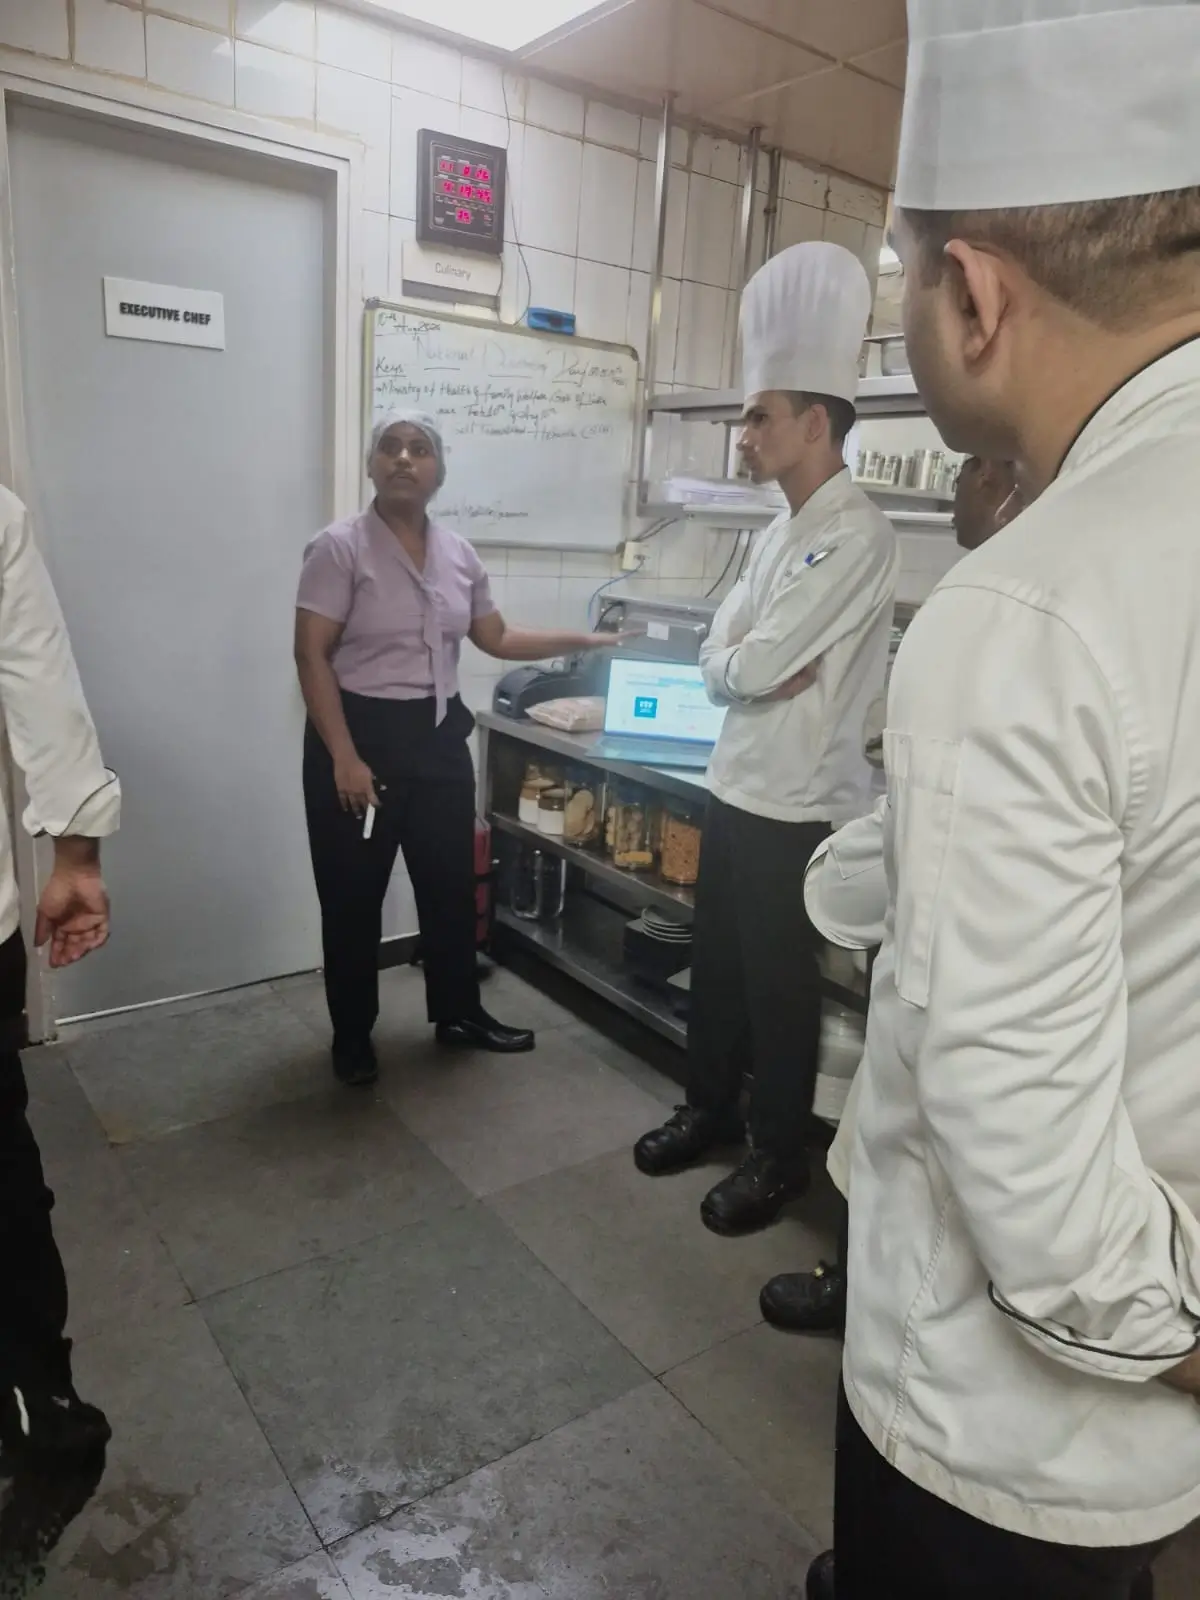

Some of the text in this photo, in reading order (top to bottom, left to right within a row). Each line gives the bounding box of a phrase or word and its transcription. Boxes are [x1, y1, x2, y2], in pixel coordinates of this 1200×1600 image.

[435, 262, 471, 281] Culinary
[119, 301, 211, 325] EXECUTIVE CHEF
